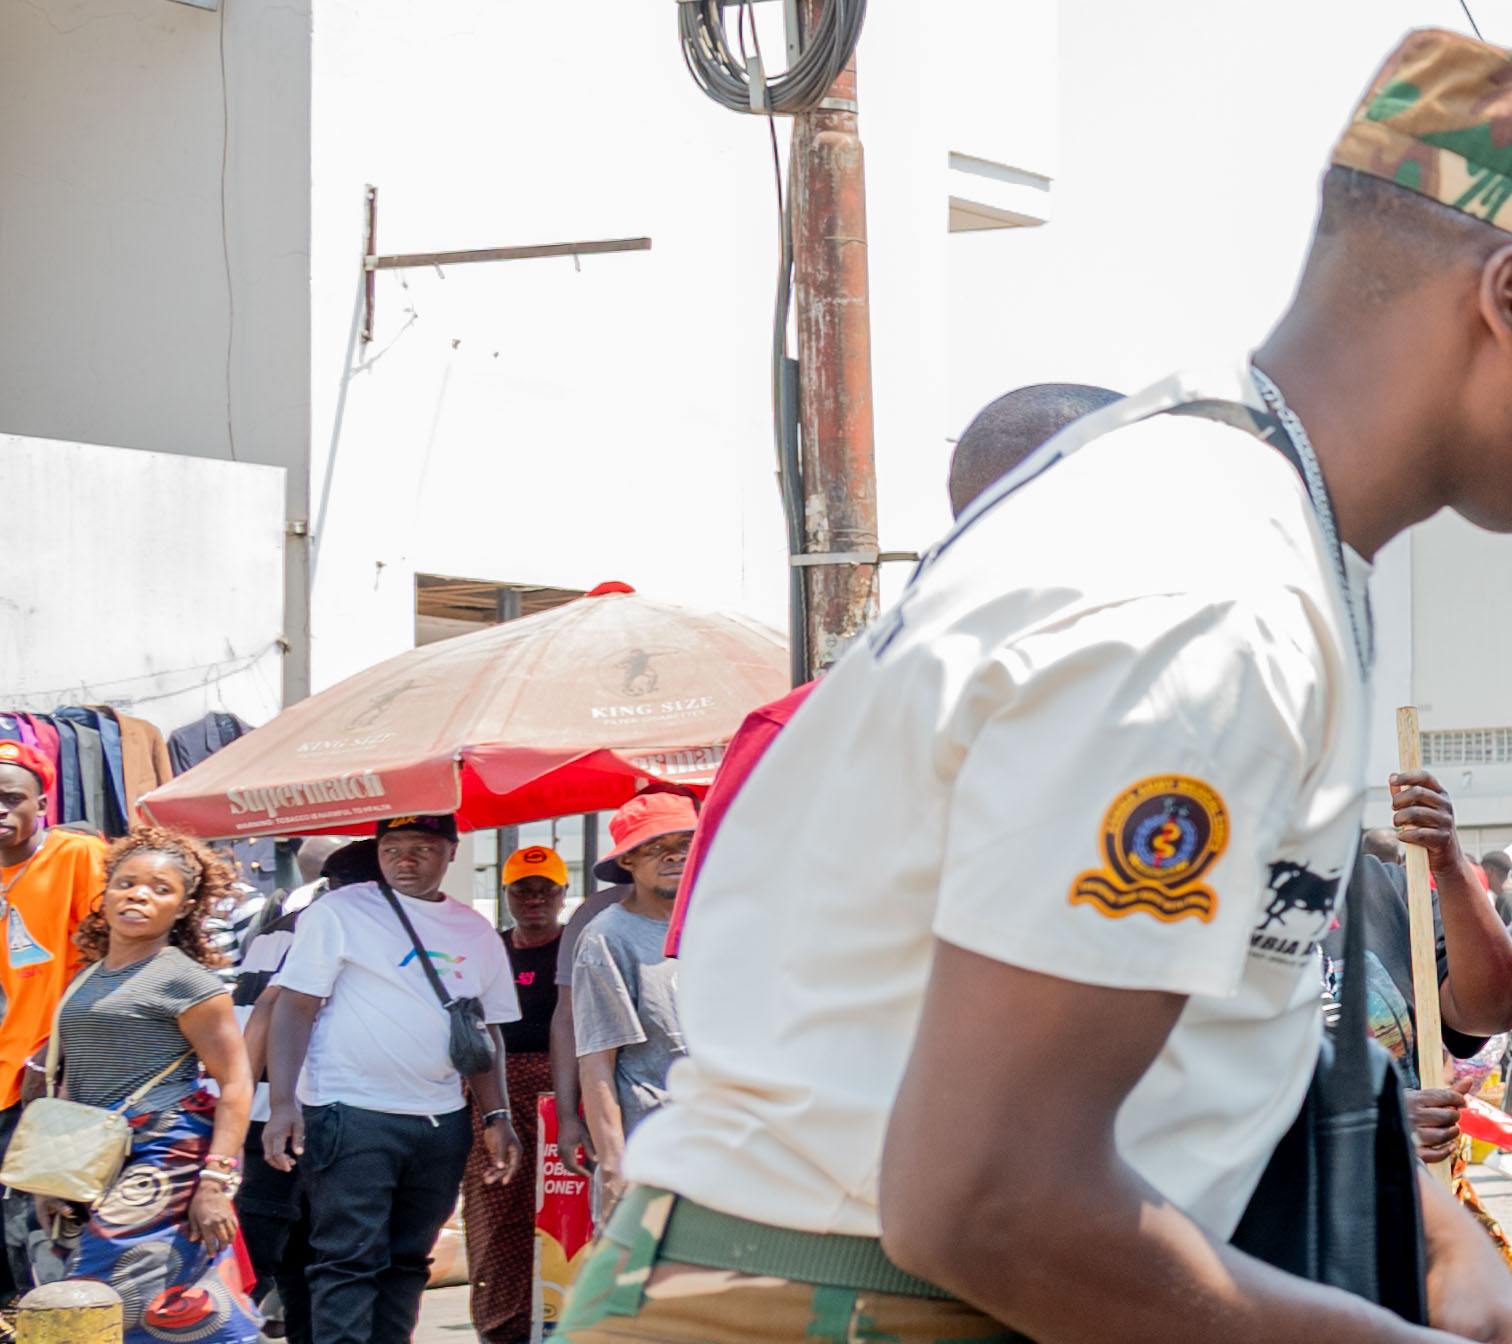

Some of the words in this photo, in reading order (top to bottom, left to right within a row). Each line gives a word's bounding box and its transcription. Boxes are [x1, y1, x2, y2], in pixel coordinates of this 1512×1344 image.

[591, 705, 653, 719] KING
[660, 695, 715, 714] SIZE
[226, 768, 385, 818] Supermatch
[544, 1180, 586, 1195] ONEY
